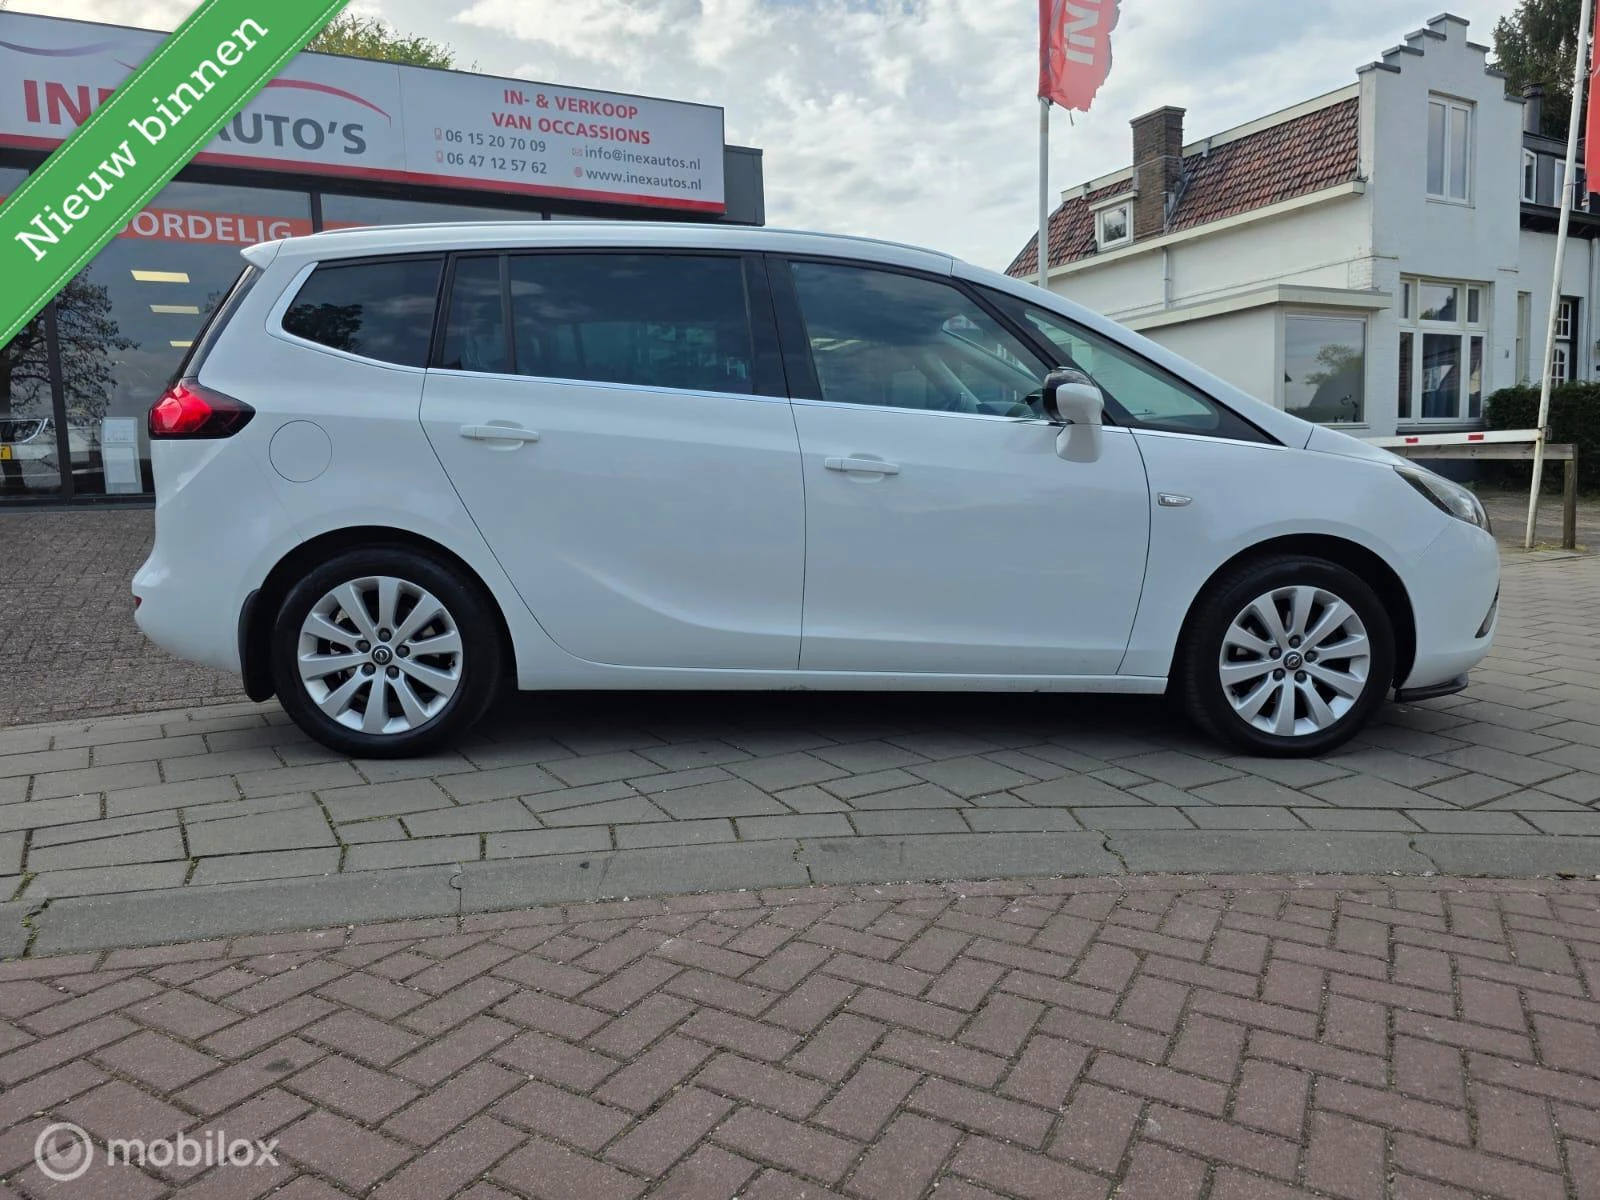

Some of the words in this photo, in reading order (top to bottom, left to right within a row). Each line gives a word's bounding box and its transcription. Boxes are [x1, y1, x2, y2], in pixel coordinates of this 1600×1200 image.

[1063, 0, 1101, 65] IN
[504, 89, 530, 106] IN-
[536, 93, 549, 109] &
[555, 95, 638, 119] VERKOOP
[492, 111, 532, 130] VAN
[538, 118, 651, 145] OCCASSIONS
[446, 129, 463, 143] 06
[468, 132, 484, 145] 15
[488, 135, 505, 148] 20
[509, 137, 526, 151] 70
[530, 140, 546, 153] 09
[447, 152, 464, 166] 06
[469, 154, 485, 168] 47
[491, 157, 507, 170] 12
[511, 159, 526, 172] 57
[531, 162, 547, 175] 62
[585, 145, 701, 170] info@inexautos.nl
[586, 169, 702, 190] www.inexautos.nl
